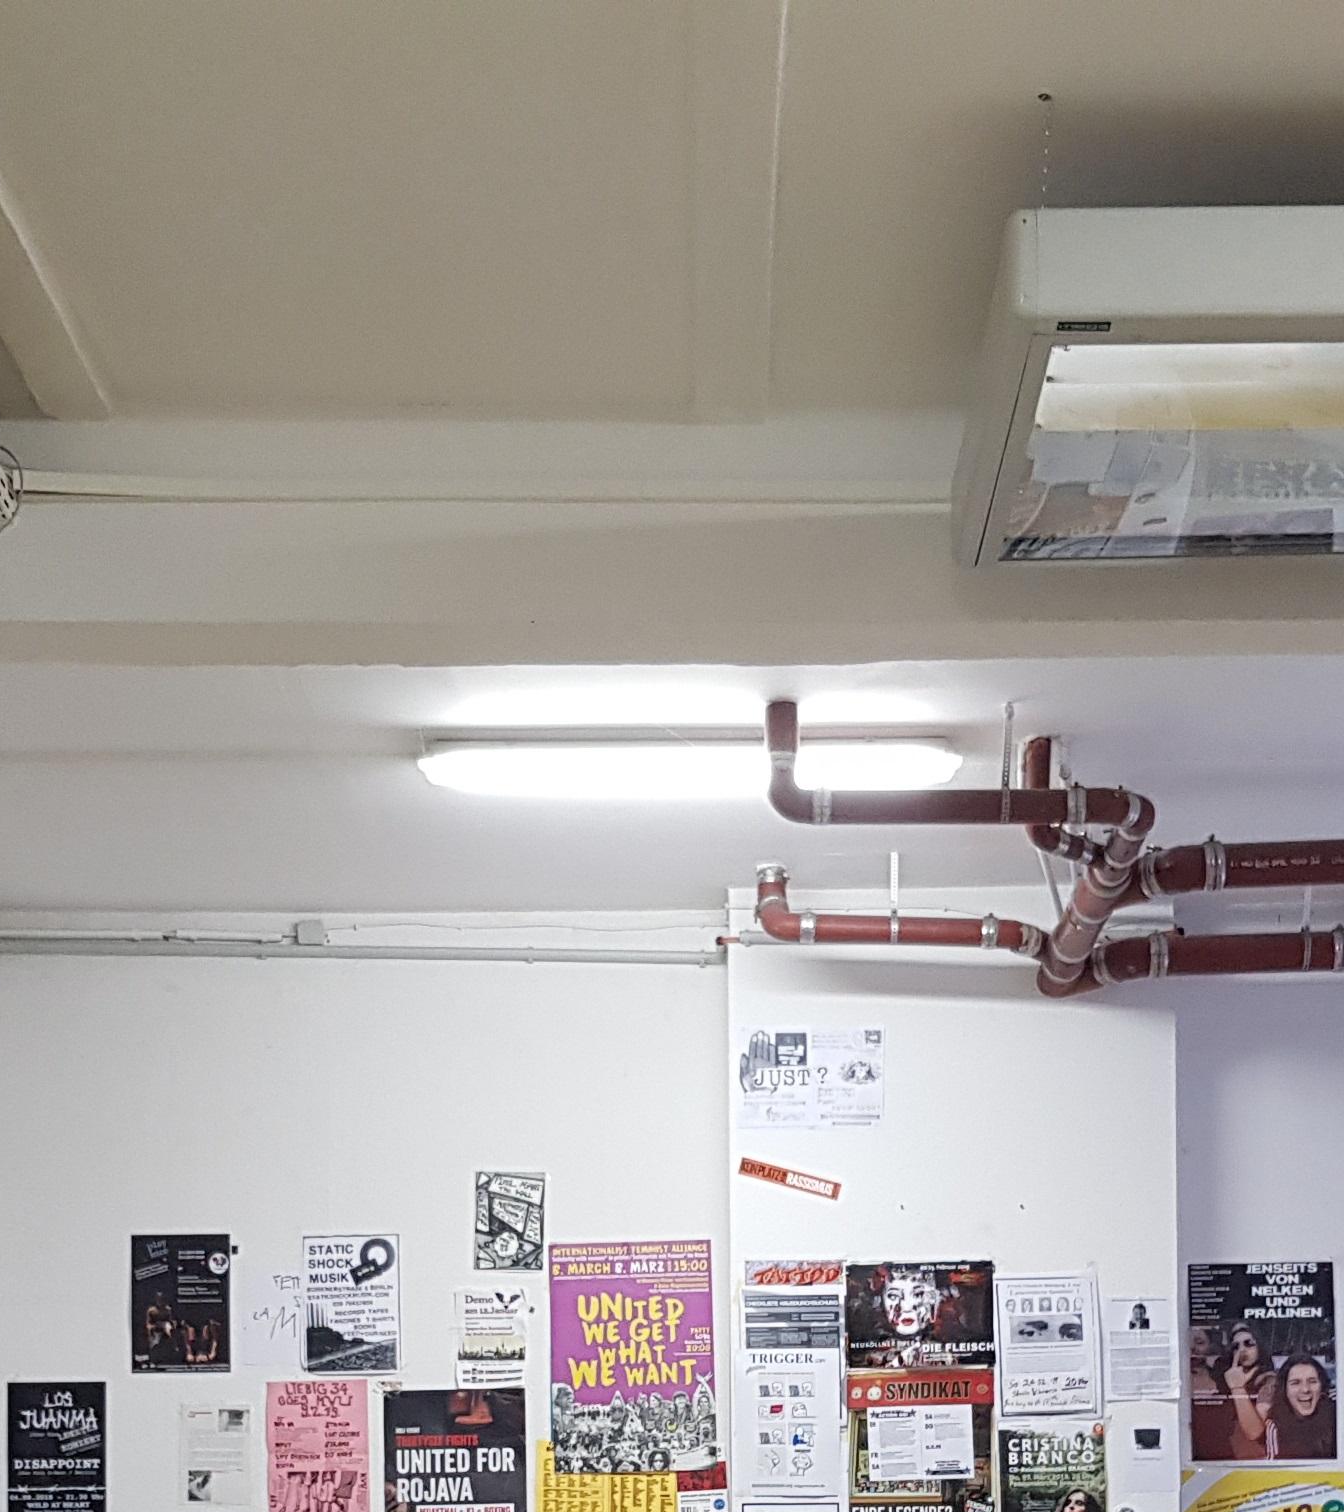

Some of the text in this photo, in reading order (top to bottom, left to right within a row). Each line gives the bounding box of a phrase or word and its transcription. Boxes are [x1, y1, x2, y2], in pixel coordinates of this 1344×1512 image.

[754, 1067, 828, 1086] JUST ?
[309, 1244, 354, 1256] STATIC
[308, 1258, 354, 1270] SHOCK
[568, 1262, 611, 1275] MARCH
[614, 1261, 627, 1274] 8.
[630, 1259, 665, 1273] MÄRZ
[674, 1260, 707, 1272] 15:00
[1246, 1262, 1318, 1275] JENSEITS
[309, 1273, 349, 1284] MUSIK
[1265, 1274, 1300, 1285] VON
[1251, 1285, 1314, 1297] NELKEN
[464, 1294, 494, 1304] Demo
[1265, 1297, 1301, 1308] UND
[577, 1292, 685, 1322] UNITED
[1244, 1307, 1323, 1319] PRALINEN
[582, 1318, 680, 1346] WE GET
[598, 1339, 666, 1367] WHAT
[922, 1342, 995, 1353] DIE FLEISCH
[749, 1353, 814, 1364] TRIGGER
[568, 1357, 697, 1390] WE WANT
[285, 1382, 349, 1396] LIEBIG 34
[886, 1380, 971, 1400] SYNDIKAT
[43, 1390, 74, 1408] LOS
[18, 1407, 98, 1430] JUANMA
[1008, 1437, 1095, 1452] CRISTINA
[14, 1458, 101, 1470] DISAPPOINT
[395, 1447, 516, 1475] UNITED FOR
[1008, 1450, 1095, 1466] BRANCO
[396, 1476, 474, 1503] ROJAVA
[26, 1501, 50, 1509] WILD
[62, 1501, 91, 1509] HEART
